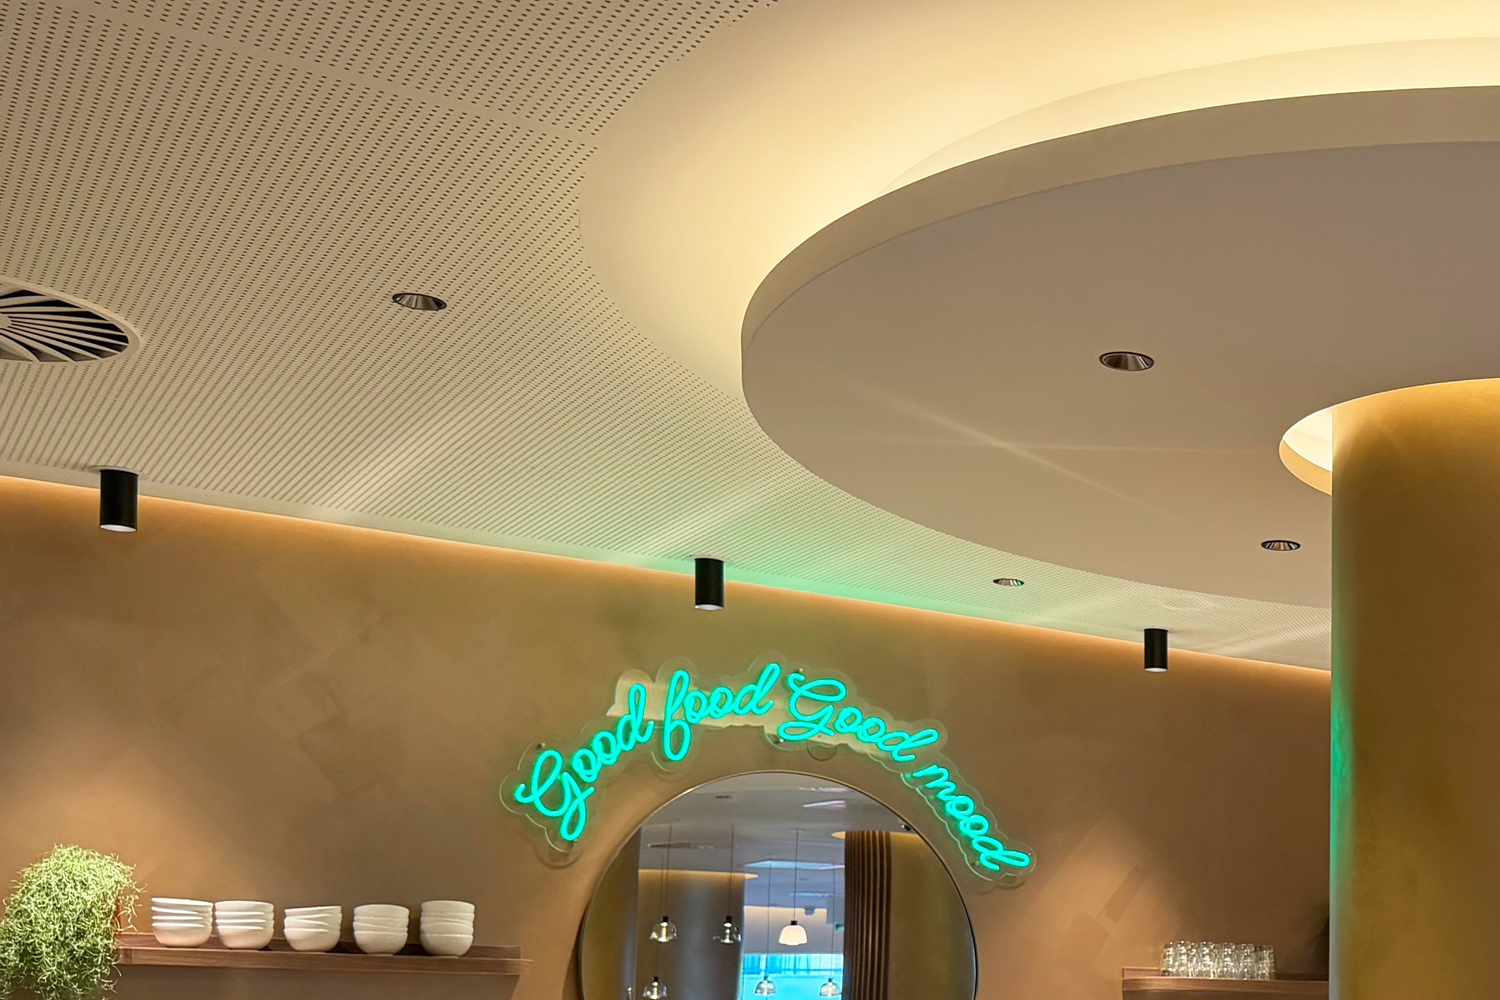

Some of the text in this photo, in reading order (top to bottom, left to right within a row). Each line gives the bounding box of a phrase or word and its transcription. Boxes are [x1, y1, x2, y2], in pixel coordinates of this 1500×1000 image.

[513, 661, 1032, 871] Good food Good mood
